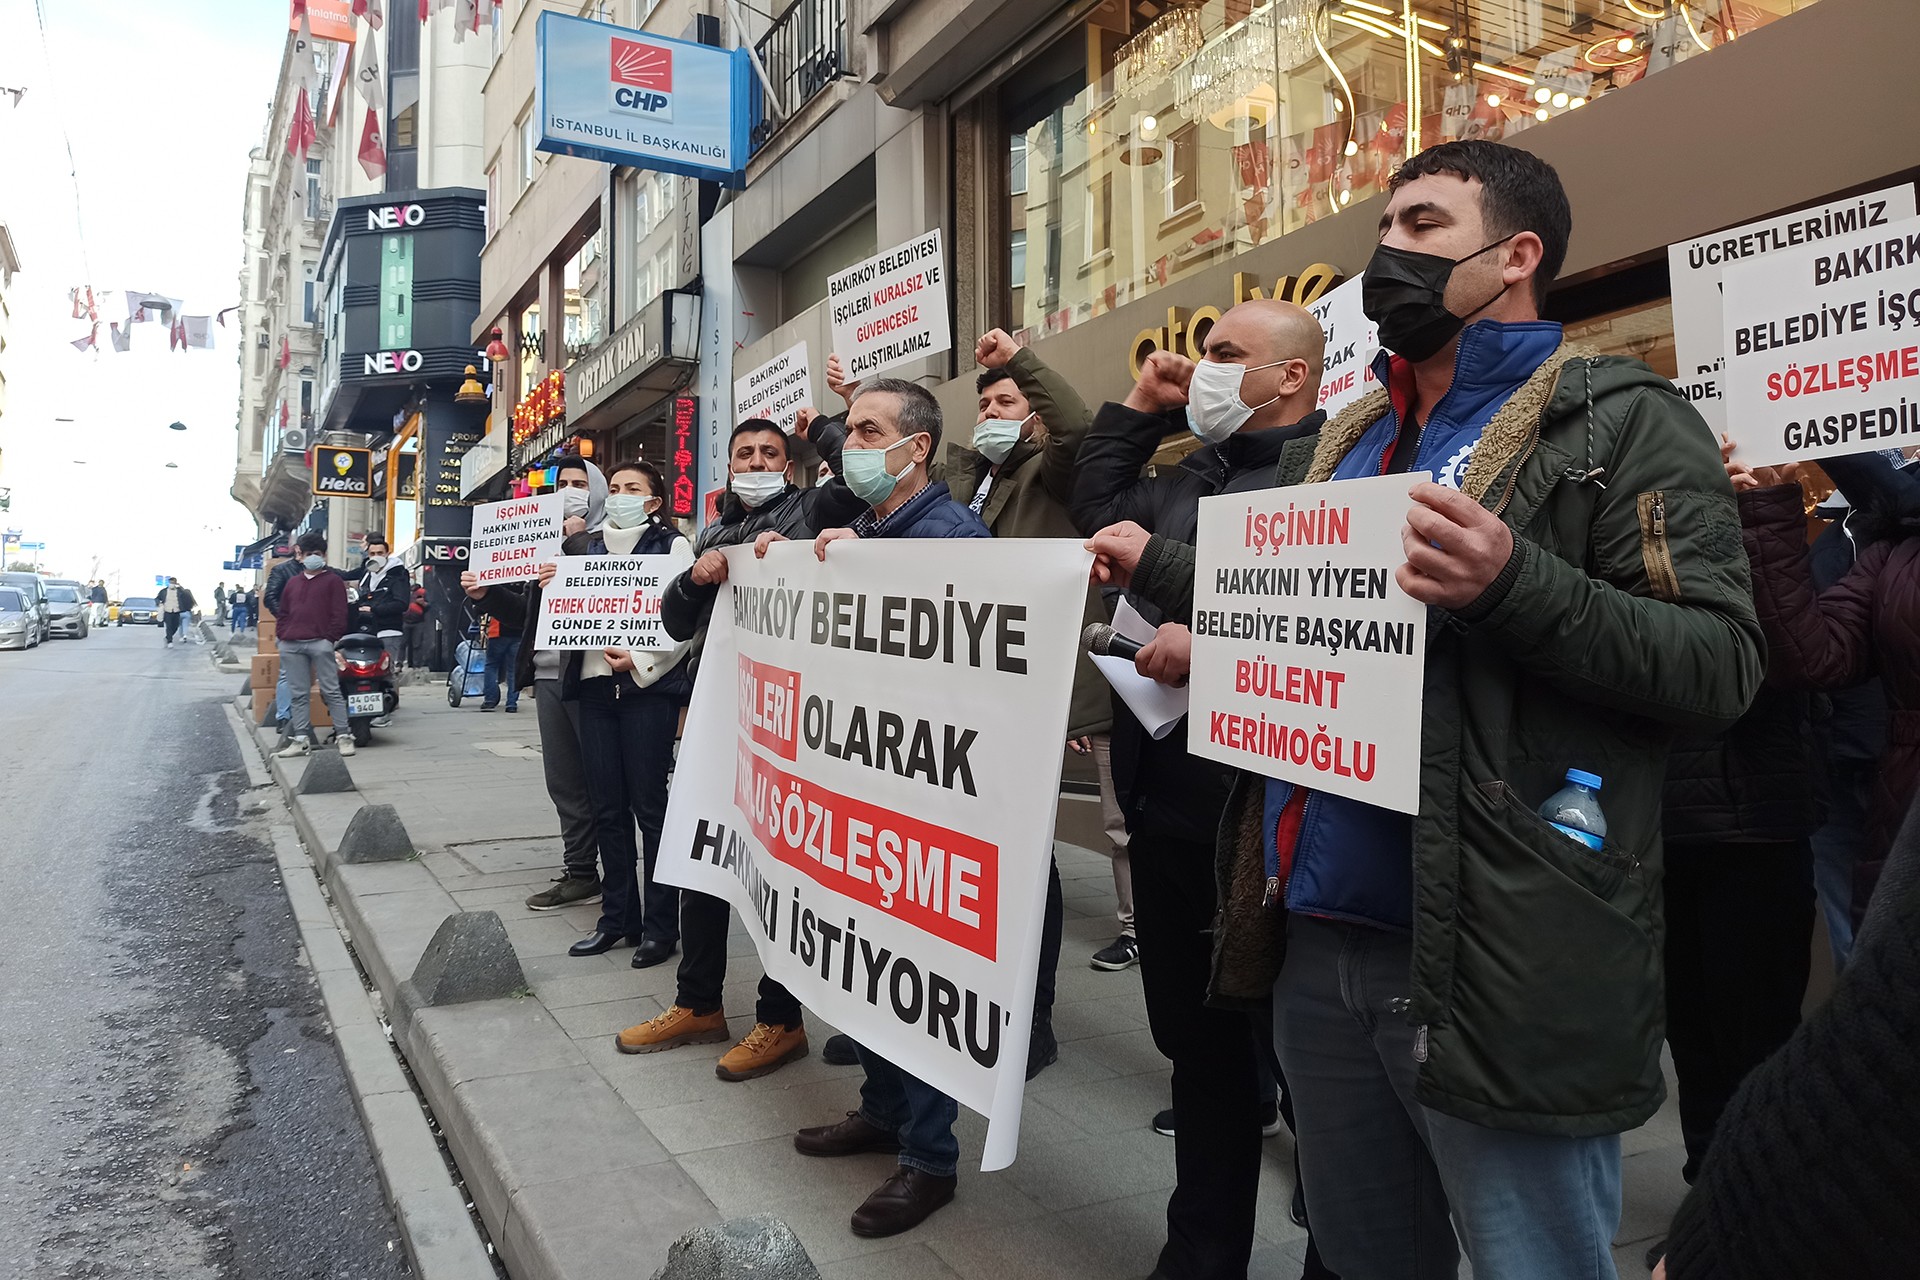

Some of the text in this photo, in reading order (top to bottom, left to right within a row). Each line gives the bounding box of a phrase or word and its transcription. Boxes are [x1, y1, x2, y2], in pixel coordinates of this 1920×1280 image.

[615, 87, 668, 113] CHP
[551, 114, 726, 159] İSTANBUL İL BAŞKANLIĞI
[368, 204, 425, 230] NEVO
[1688, 200, 1888, 269] ÜCRETLERİMİZ
[831, 233, 938, 297] BAKIRKÖY BELEDİYESİ
[834, 267, 940, 326] İŞÇİLERİ KURALSIZ VE
[856, 304, 919, 343] GÜVENCESİZ
[1735, 302, 1867, 356] BELEDİYE
[364, 350, 423, 375] NEVO
[577, 346, 615, 403] ORTAK
[617, 323, 645, 374] HAN
[750, 356, 790, 388] BAKIRKÖY
[851, 331, 931, 378] ÇALIŞTIRILAMAZ
[1767, 345, 1919, 401] SÖZLEŞME
[738, 366, 807, 414] BELEDİYESİ'NDEN
[772, 388, 805, 413] İŞÇİLER
[320, 477, 366, 491] Heka
[482, 517, 552, 535] HAKKINI YİYEN
[496, 502, 539, 521] İŞÇİNİN
[1244, 499, 1350, 556] İŞÇİNİN
[425, 545, 469, 560] NEVO
[473, 530, 559, 549] BELEDİYE BAŞKANI
[491, 547, 537, 563] BÜLENT
[565, 574, 659, 587] BELEDİYESİ'NDE
[584, 559, 643, 572] BAKIRKÖY
[1215, 560, 1388, 600] HAKKINI YİYEN
[547, 590, 662, 614] YEMEK ÜCRETİ 5 LİR
[548, 635, 661, 647] HAKKIMIZ VAR.
[551, 617, 662, 631] GÜNDE 2 SİMİT
[732, 577, 1028, 676] BAKIRKÖY BELEDİYE
[1196, 607, 1415, 657] BELEDİYE BAŞKANI
[350, 696, 361, 704] 34
[1235, 654, 1346, 710] BÜLENT
[356, 704, 374, 712] 940
[737, 655, 979, 798] İŞÇİLERİ OLARAK
[1210, 710, 1376, 782] KERİMOĞLU
[768, 781, 982, 930] SÖZLEŞME
[789, 886, 1011, 1069] İSTİYORU
